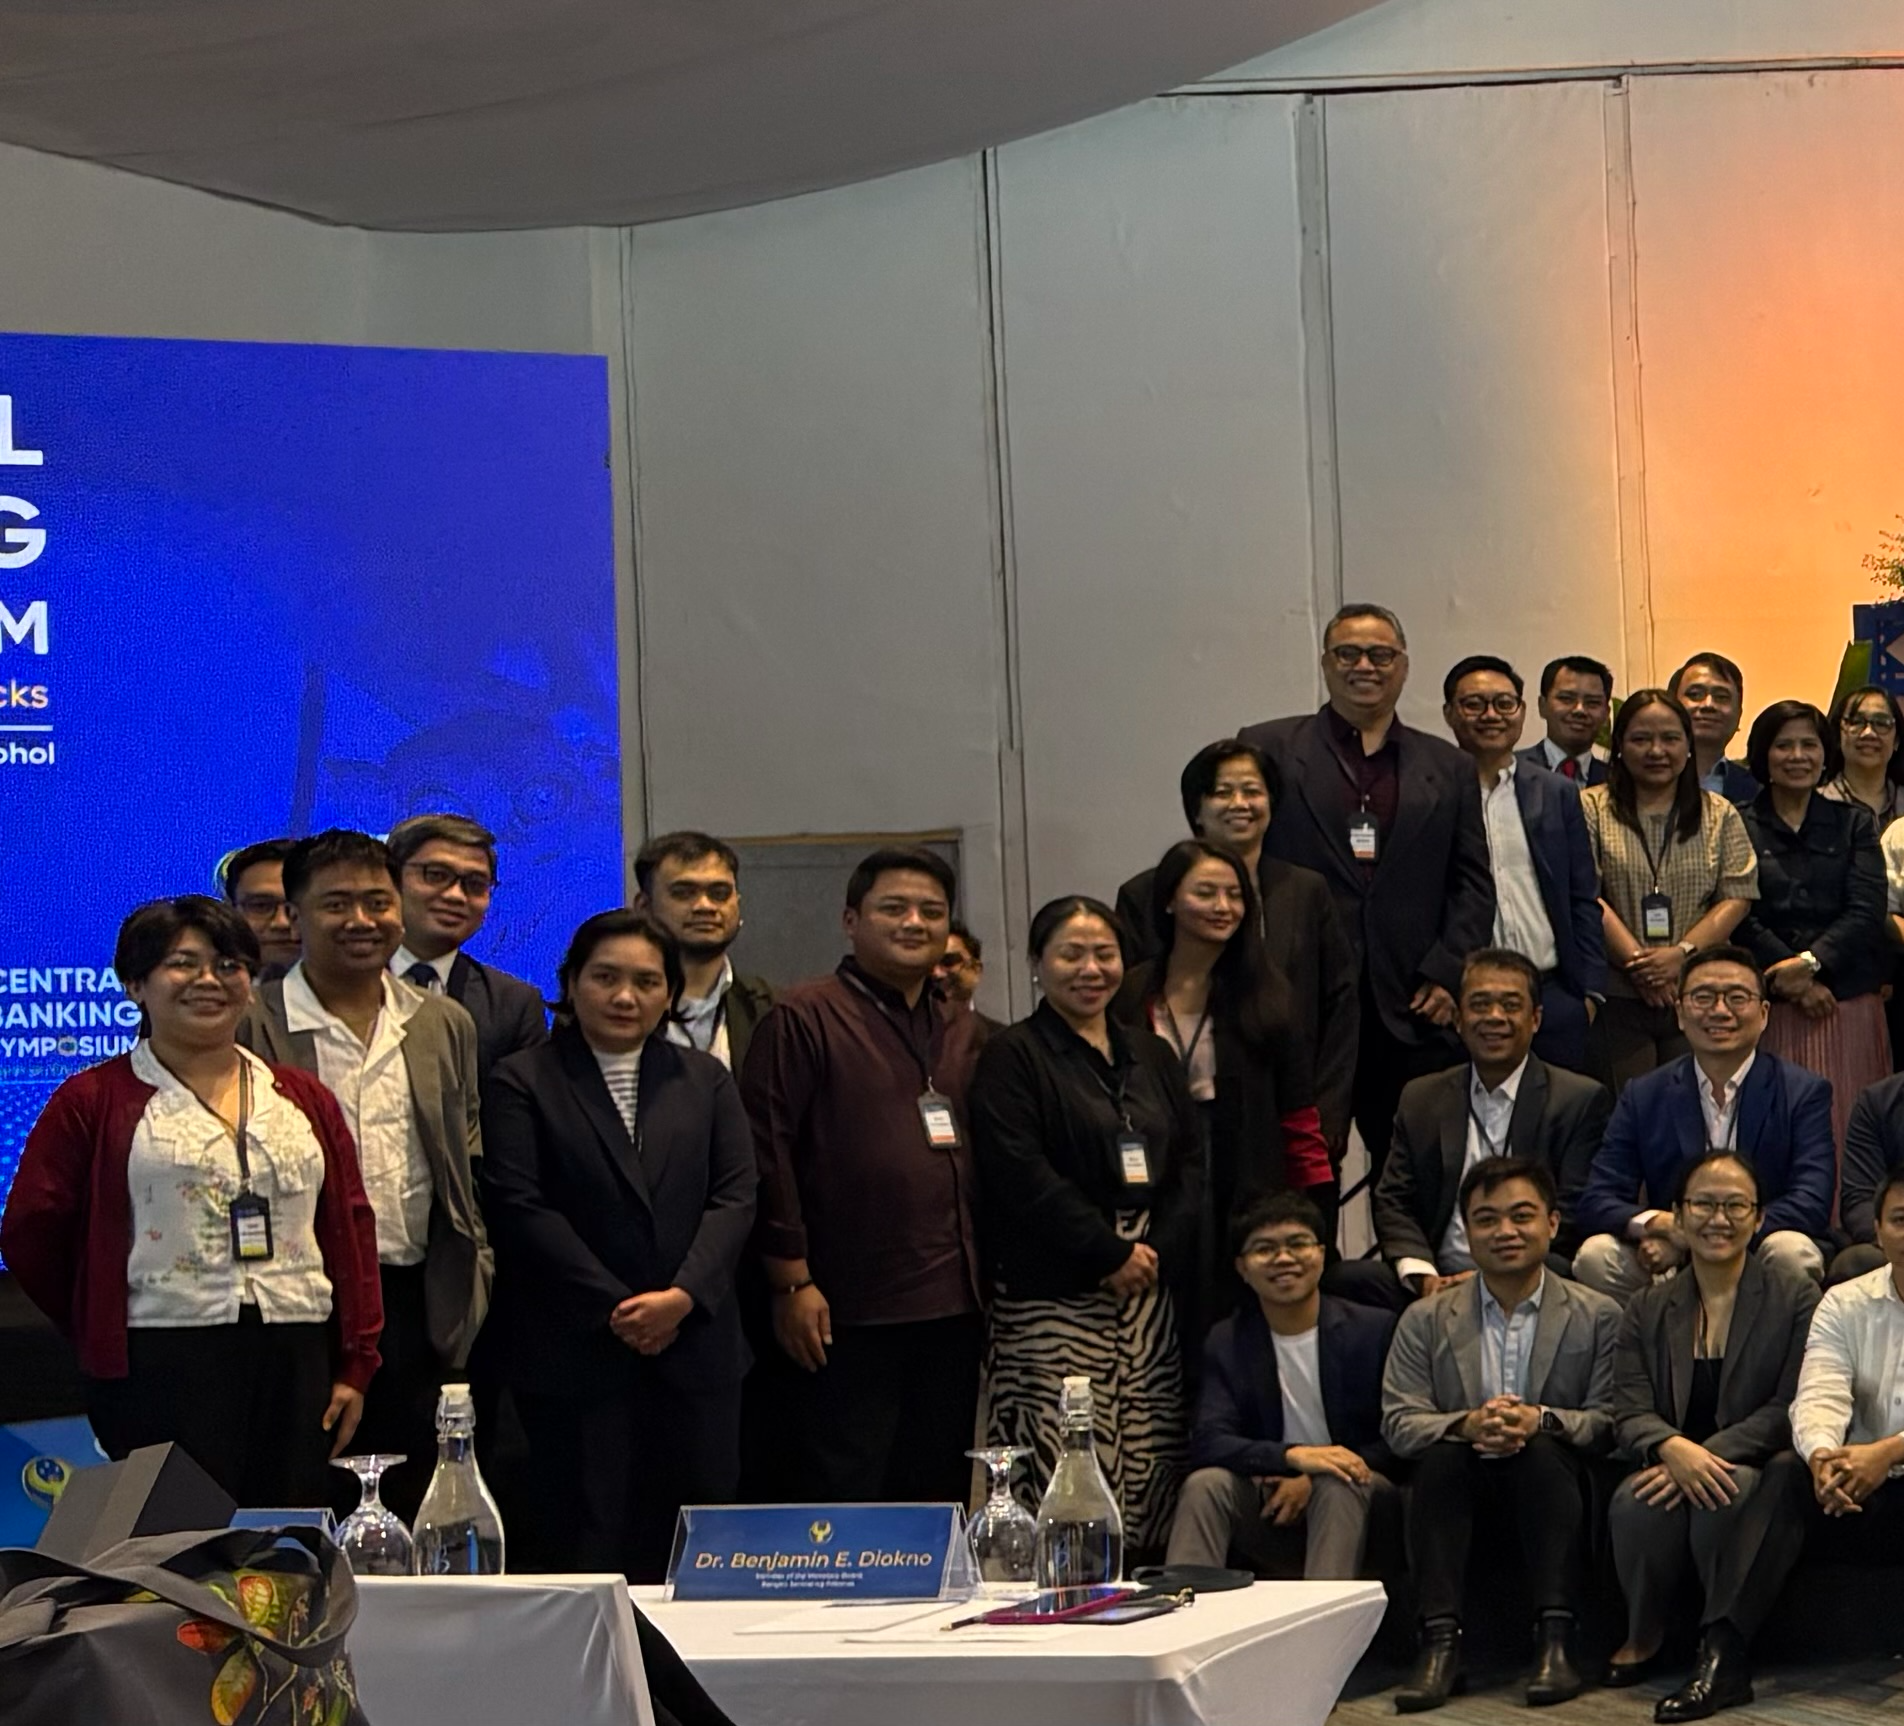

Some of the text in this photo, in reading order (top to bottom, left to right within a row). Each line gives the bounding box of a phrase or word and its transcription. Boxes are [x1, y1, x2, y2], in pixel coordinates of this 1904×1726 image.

[0, 967, 126, 993] ENTRA
[0, 1000, 142, 1029] ANKING
[0, 1035, 140, 1058] YMPOSIUM
[695, 1549, 933, 1572] Dr. Benjamin E. Diokno
